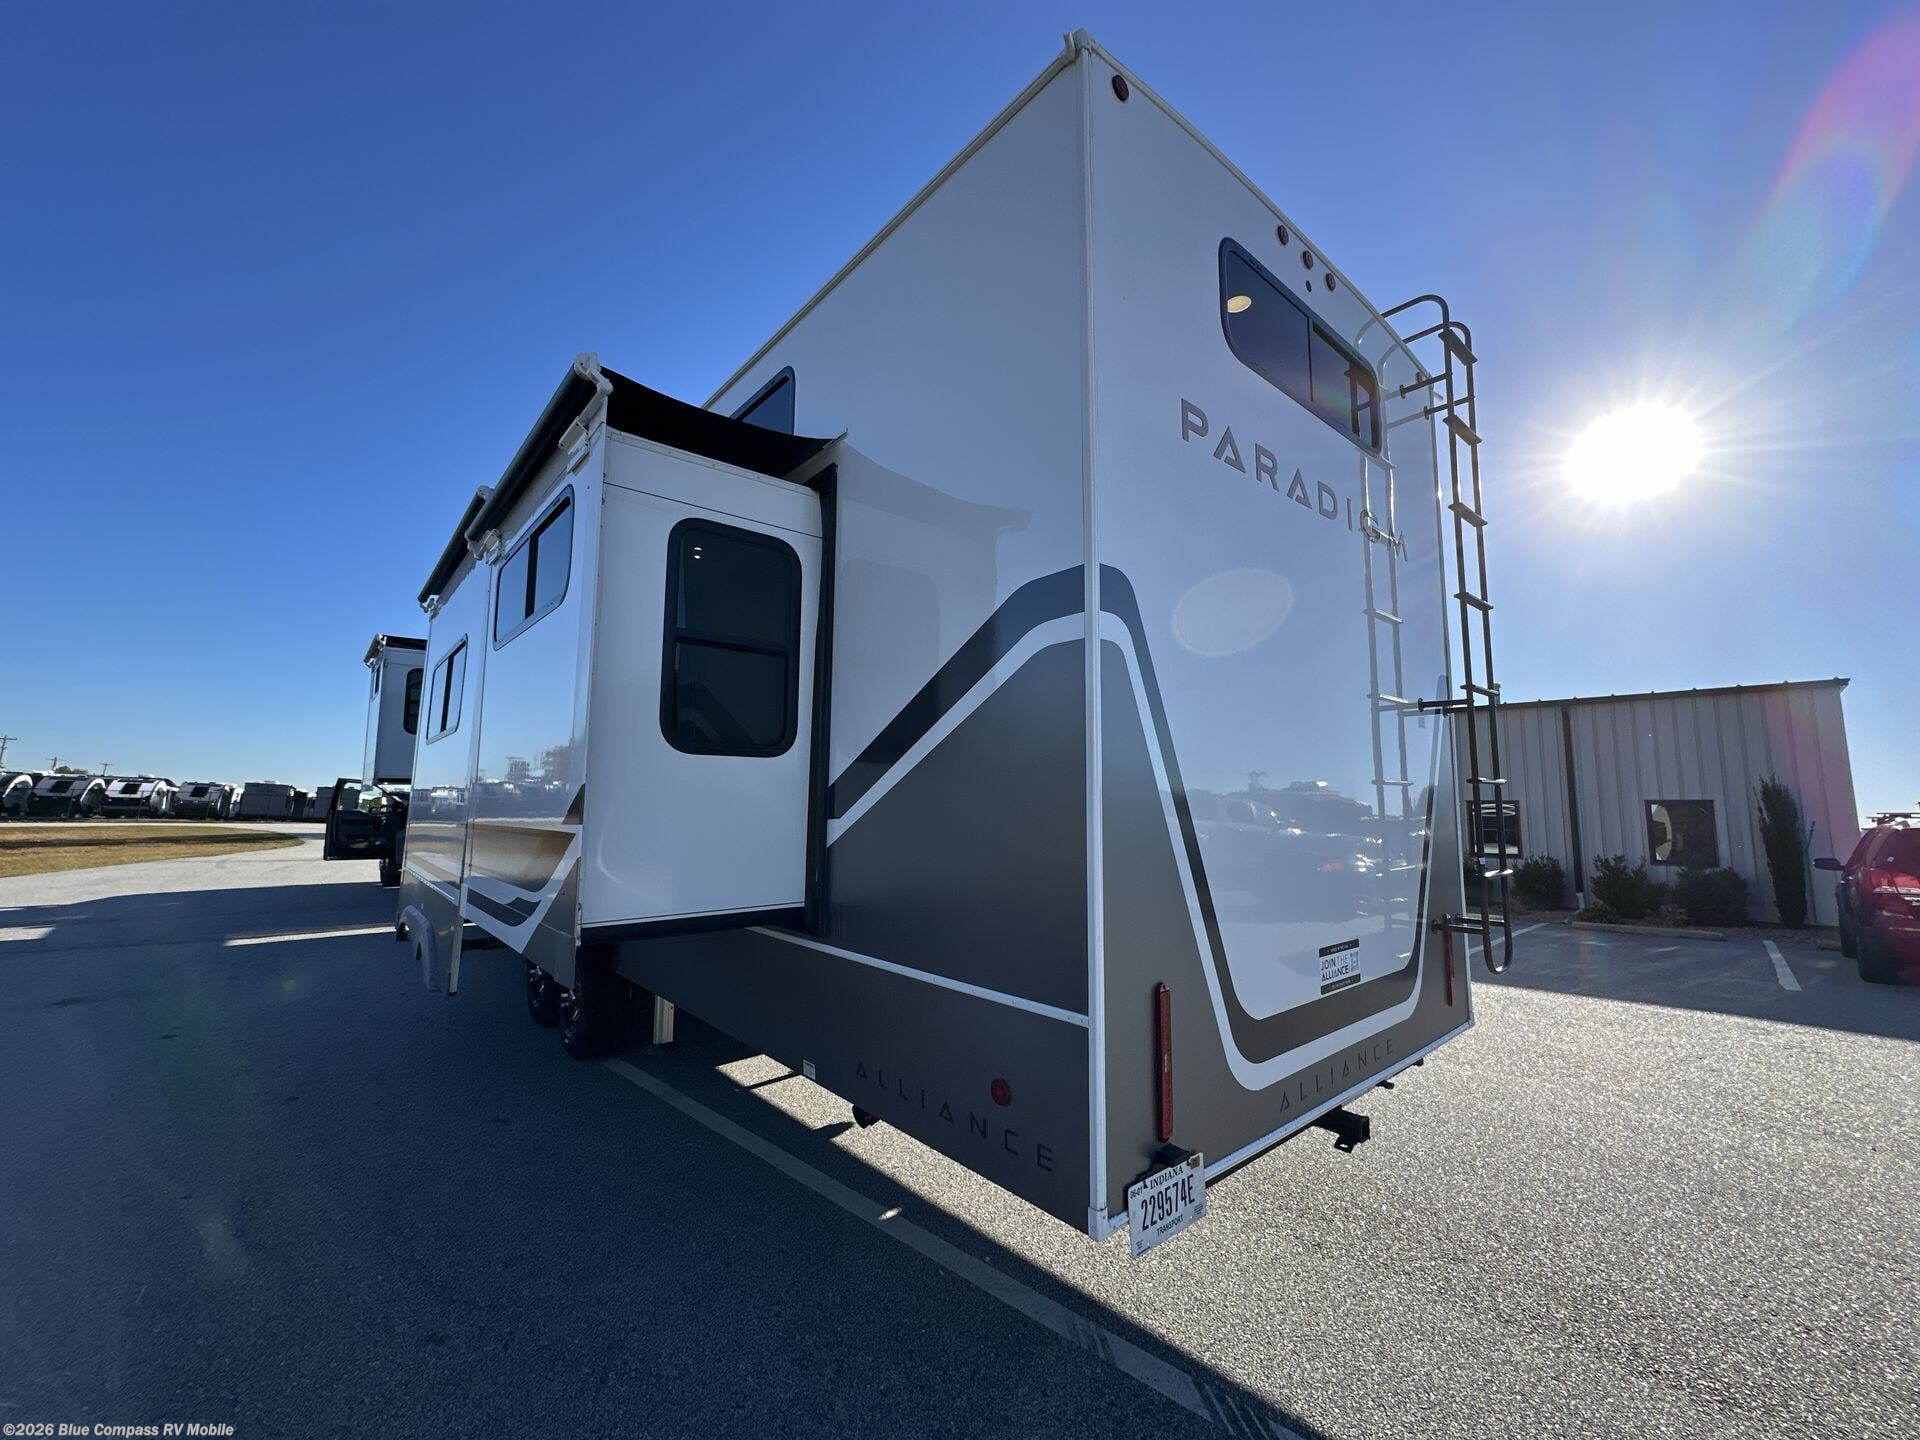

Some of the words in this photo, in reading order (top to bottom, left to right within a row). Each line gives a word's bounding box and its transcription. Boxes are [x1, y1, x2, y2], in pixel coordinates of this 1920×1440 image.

[1321, 958, 1336, 971] JOIN
[1335, 953, 1349, 967] THE
[1321, 964, 1349, 981] ALLIANCE
[1280, 1038, 1393, 1112] ALLIANCE
[855, 1060, 1053, 1172] ALLIANCE
[1150, 1166, 1184, 1189] INDIANA
[1141, 1174, 1195, 1231] 229574E
[1156, 1214, 1184, 1237] TRANSPORT
